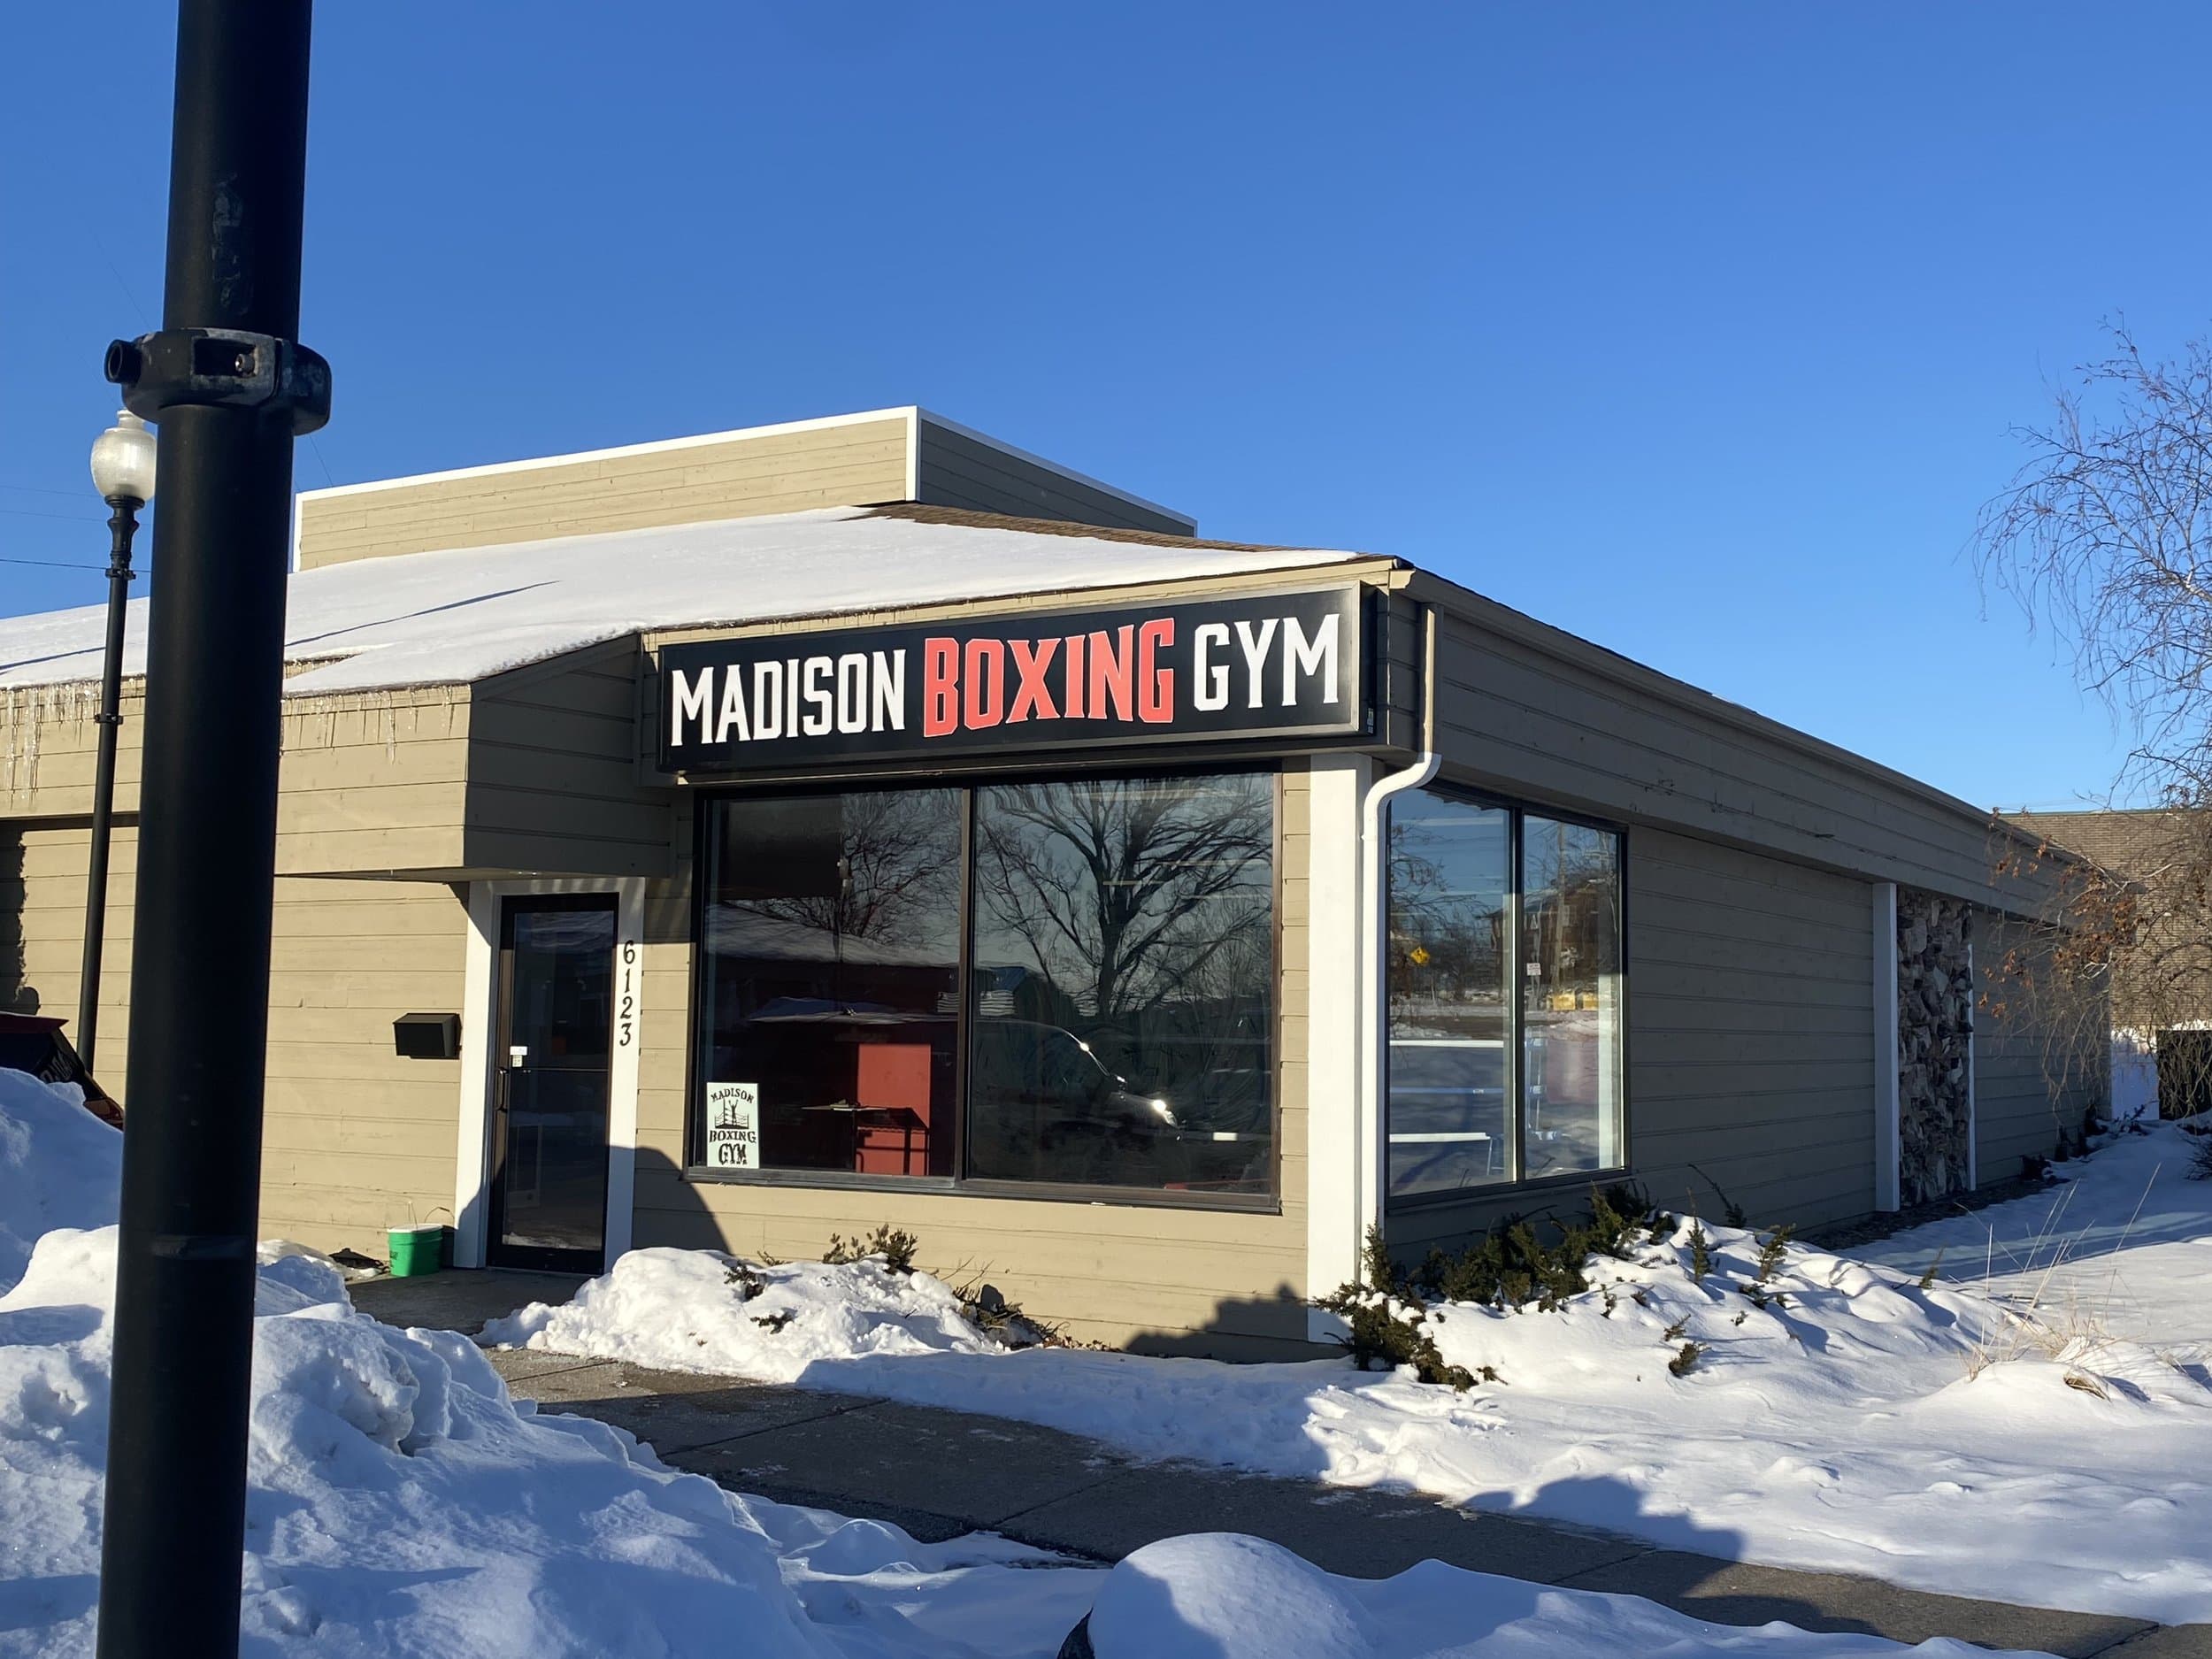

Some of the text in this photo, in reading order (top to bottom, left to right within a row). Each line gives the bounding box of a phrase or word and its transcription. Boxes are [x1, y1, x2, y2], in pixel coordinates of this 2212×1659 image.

[671, 612, 1340, 748] MADISON BOXING GYM
[619, 940, 635, 1046] 6123
[710, 1087, 754, 1103] MADISON
[709, 1130, 757, 1144] BOXING
[718, 1142, 748, 1165] GYM
